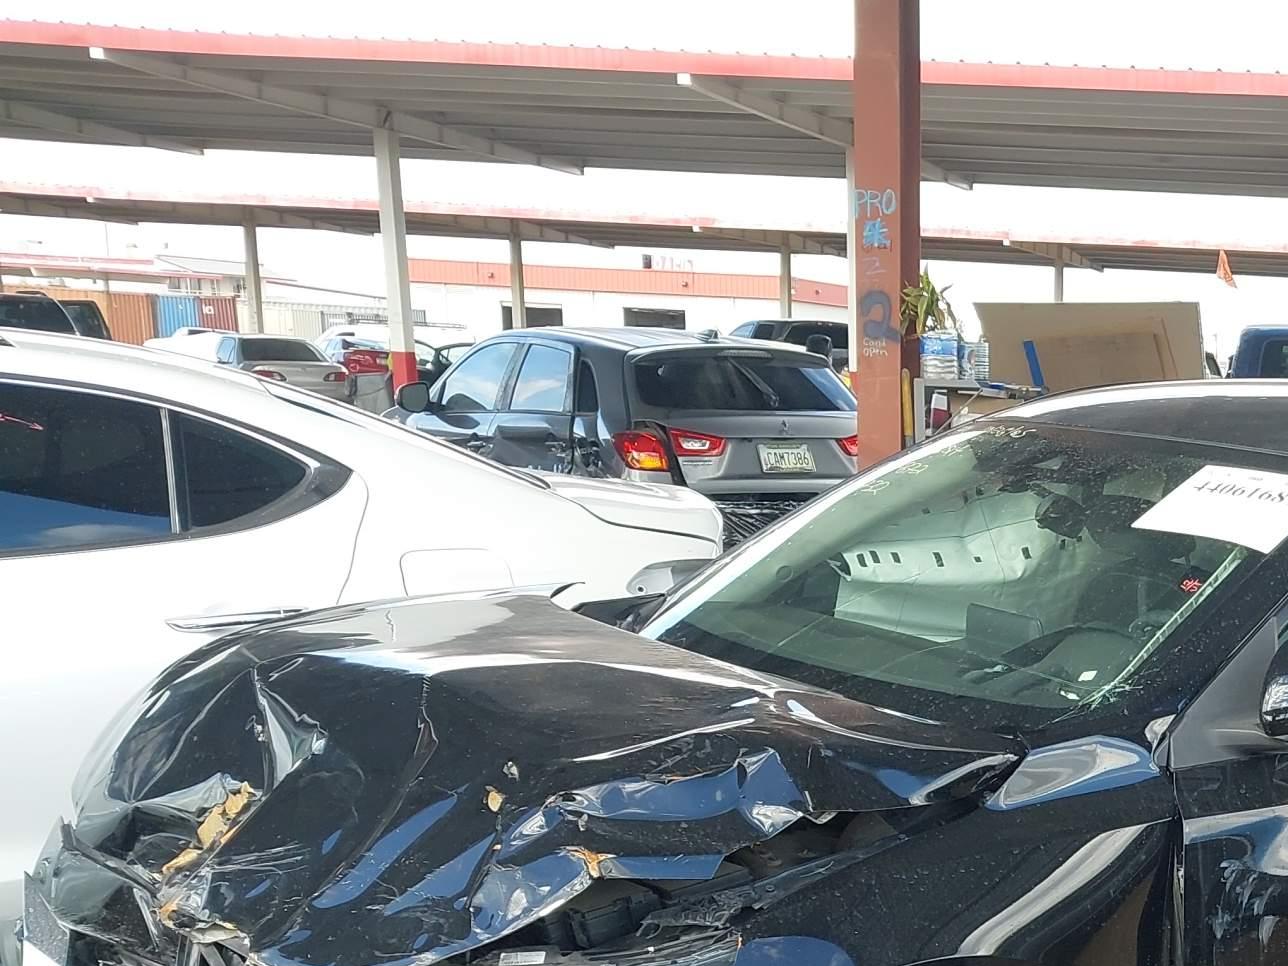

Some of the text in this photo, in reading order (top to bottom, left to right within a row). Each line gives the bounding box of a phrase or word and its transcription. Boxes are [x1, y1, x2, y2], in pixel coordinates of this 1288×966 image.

[853, 188, 897, 218] PRO
[862, 288, 902, 344] 2
[766, 451, 810, 466] CAM7386
